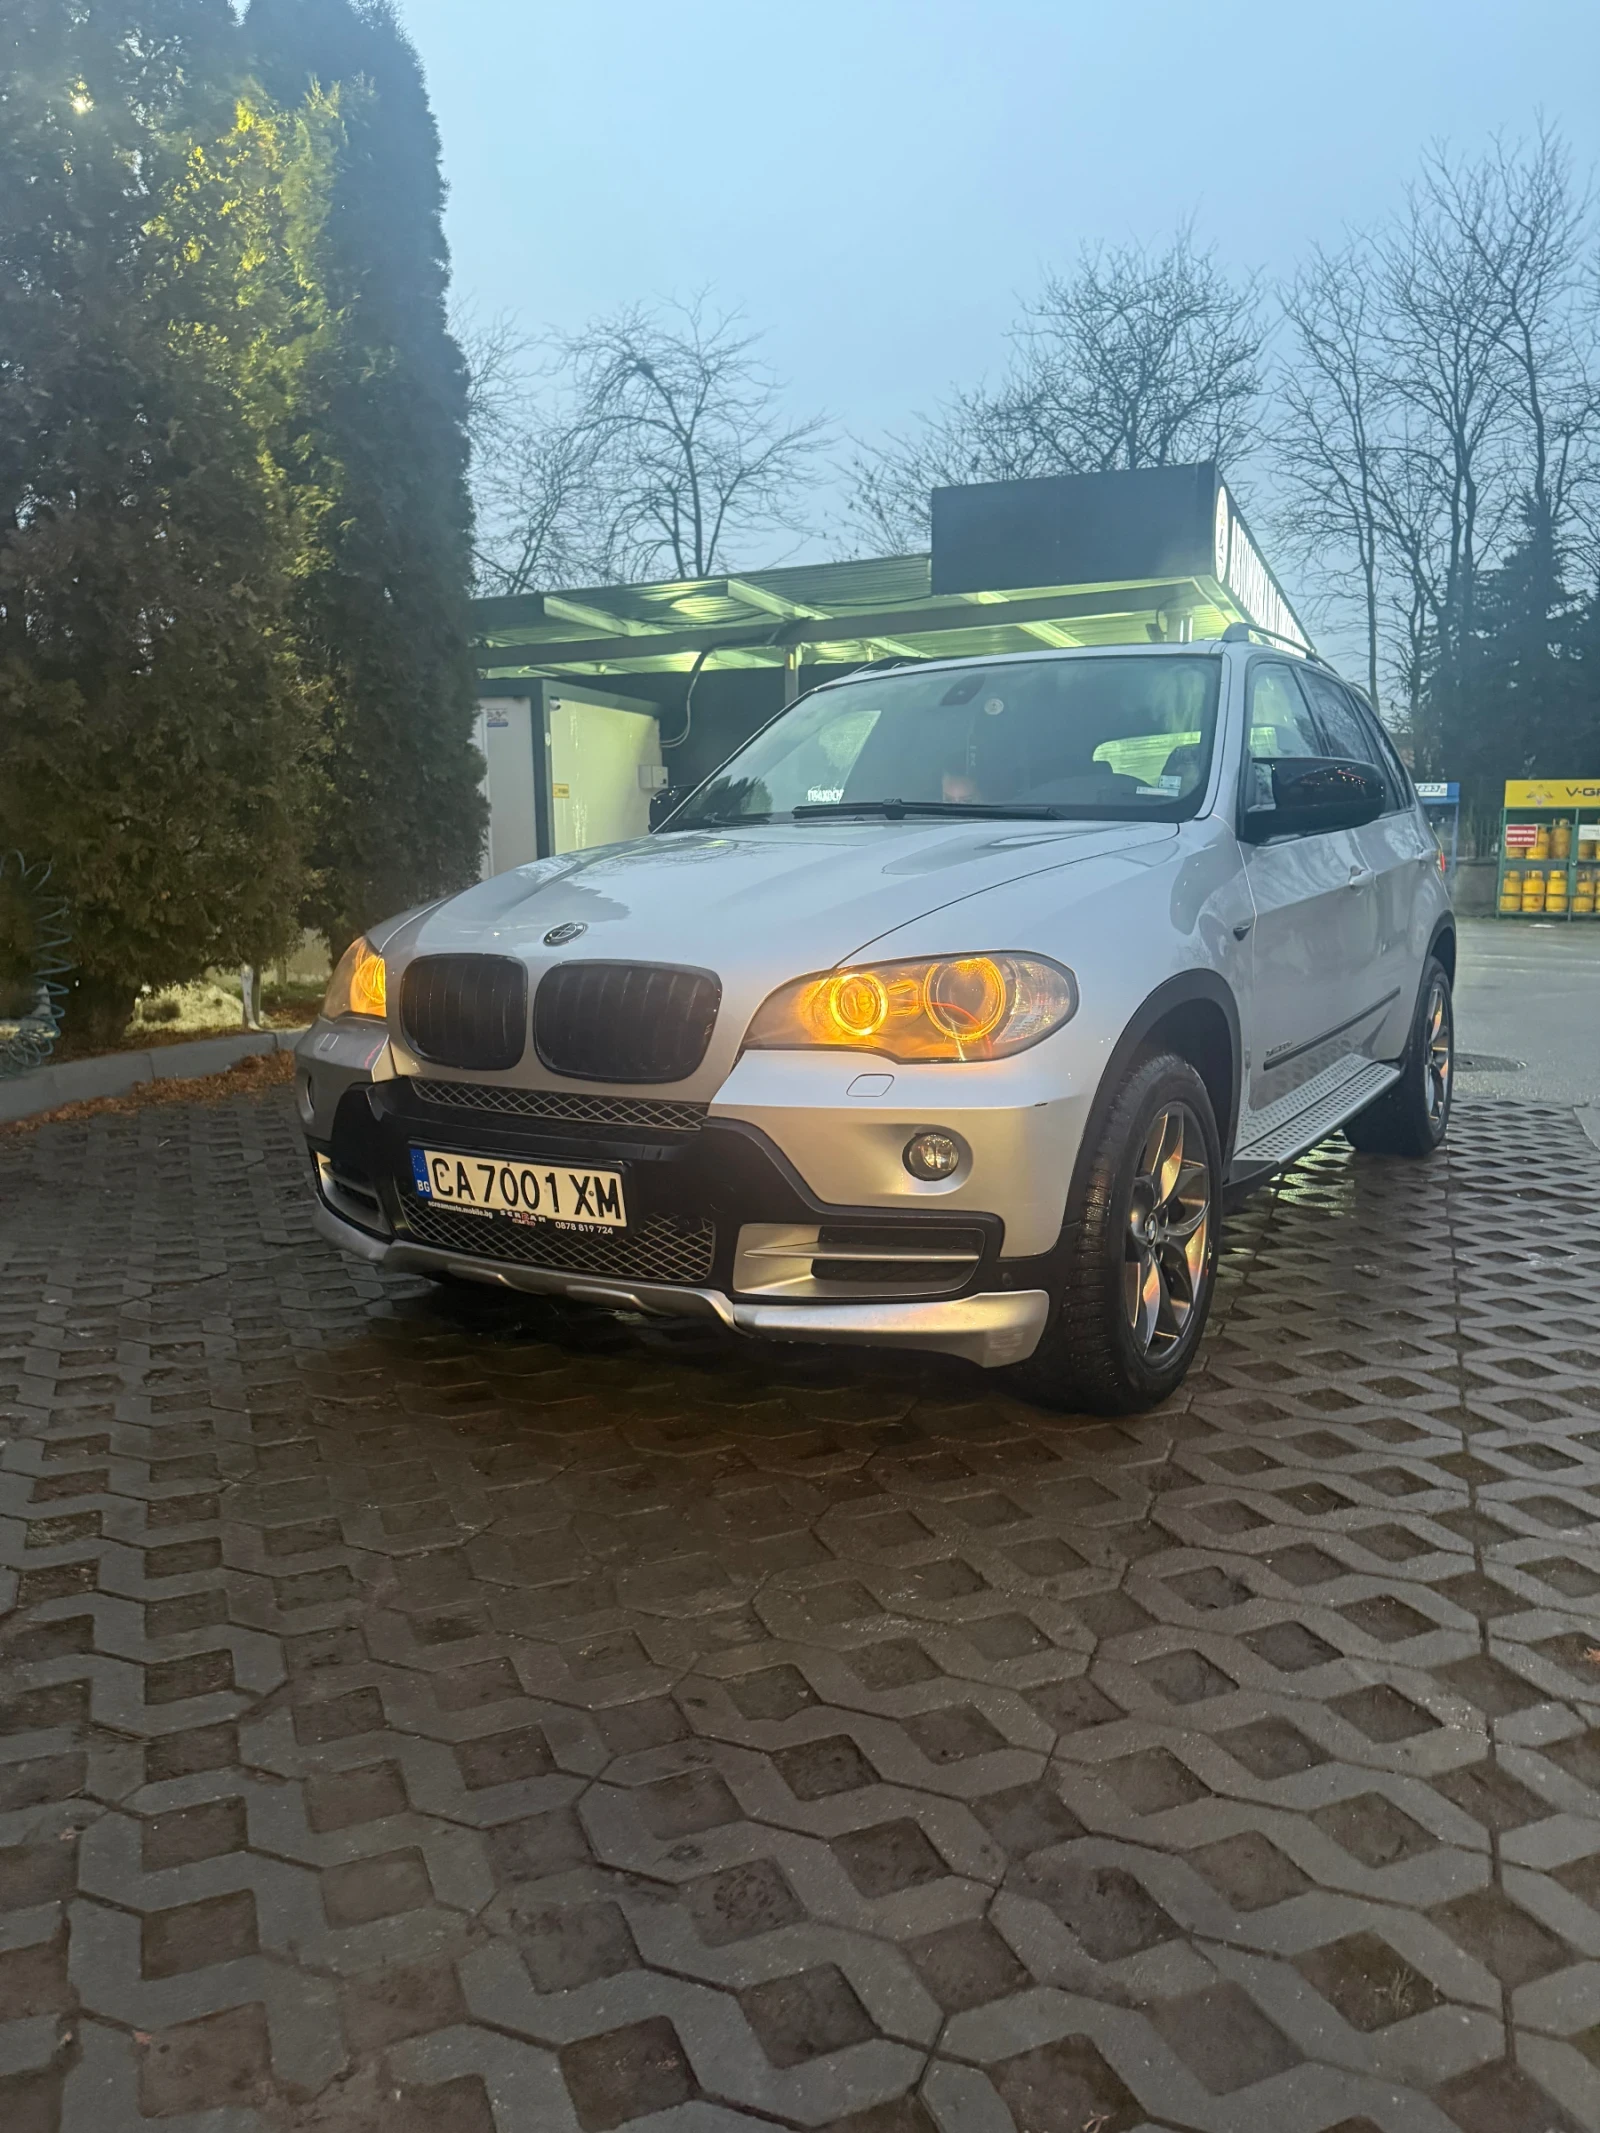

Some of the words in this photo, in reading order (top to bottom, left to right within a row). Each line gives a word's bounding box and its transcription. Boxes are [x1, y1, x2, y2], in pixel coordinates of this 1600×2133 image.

[417, 1179, 431, 1193] BG
[427, 1200, 493, 1219] screamauto.mobile.bg
[555, 1221, 577, 1231] 0878
[578, 1224, 595, 1233] 819
[596, 1226, 614, 1235] 724
